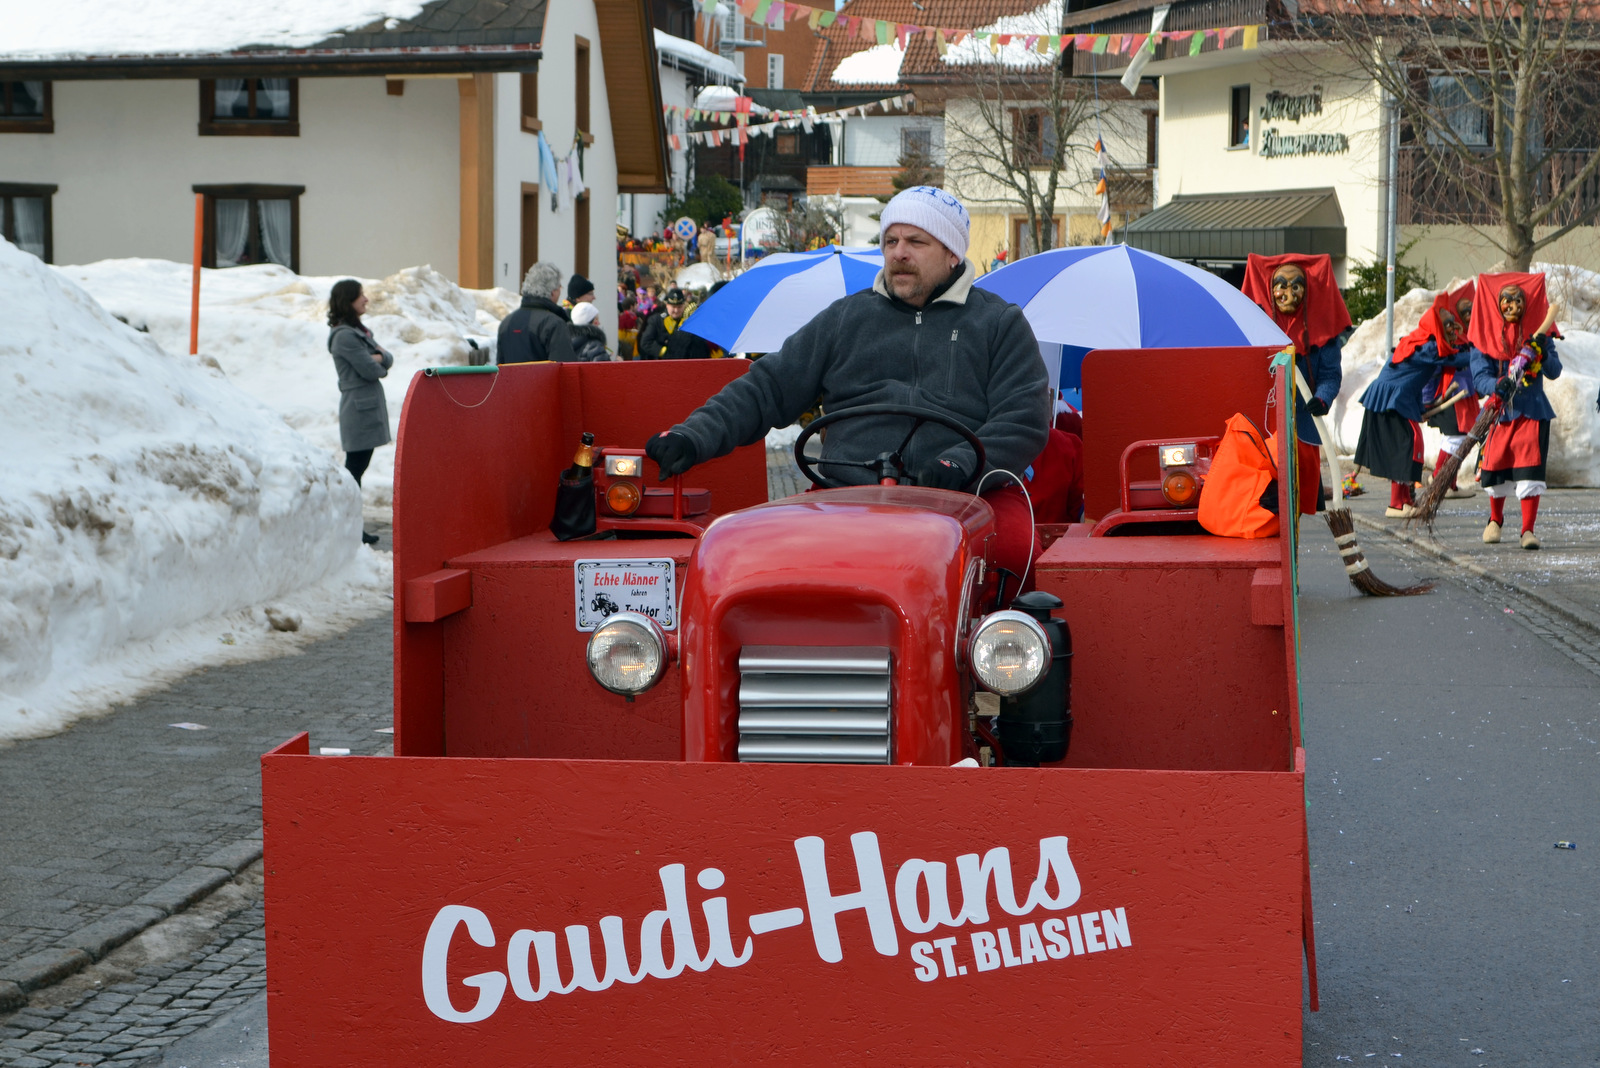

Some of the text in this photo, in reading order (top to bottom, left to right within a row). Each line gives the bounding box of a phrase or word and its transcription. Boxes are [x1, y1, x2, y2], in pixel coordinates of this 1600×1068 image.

[594, 572, 659, 586] Echte Männer
[625, 604, 660, 618] Tktor
[422, 831, 1081, 1023] Gaudi-Hans
[911, 907, 1132, 982] ST. BLASIEN
